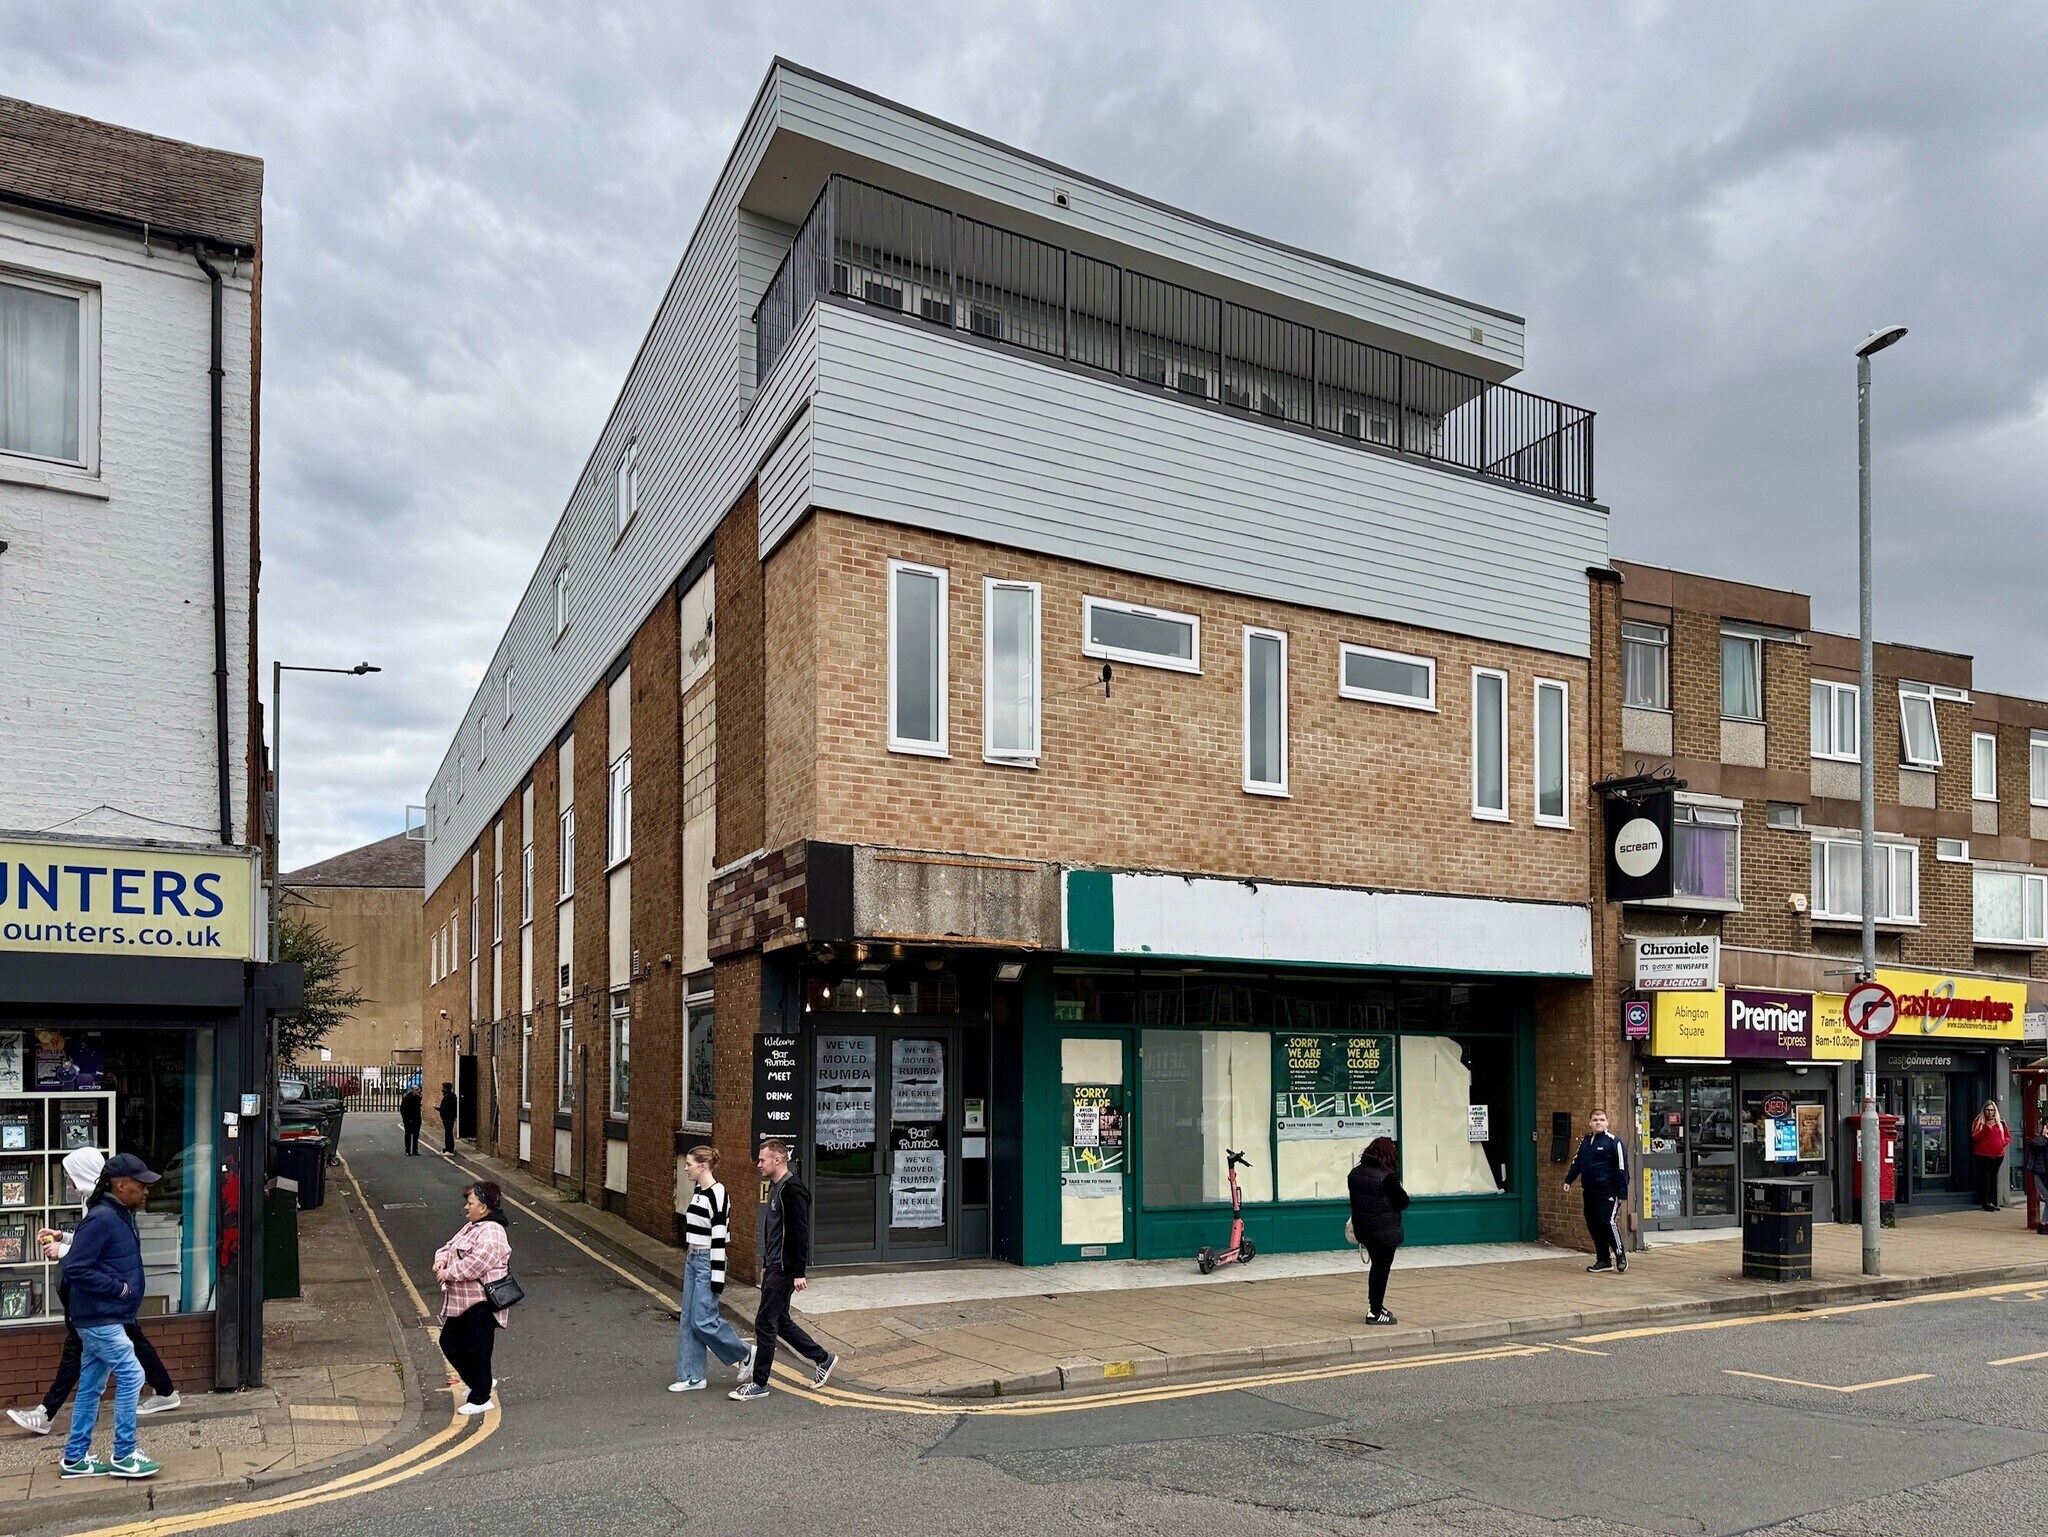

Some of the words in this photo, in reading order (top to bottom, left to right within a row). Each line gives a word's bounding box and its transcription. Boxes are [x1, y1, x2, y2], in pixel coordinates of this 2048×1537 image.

[1619, 841, 1658, 853] scream
[0, 861, 224, 918] NTERS
[3, 921, 222, 947] ounters.co.uk
[1640, 941, 1709, 956] Chronicle
[1644, 980, 1662, 988] OFF
[1663, 979, 1704, 987] LICENCE
[1674, 1005, 1709, 1022] Abington
[1731, 999, 1807, 1033] Premier
[1679, 1023, 1705, 1039] Square
[764, 1036, 795, 1047] Welcome
[825, 1040, 864, 1050] WE'VE
[1290, 1038, 1319, 1048] SORRY
[1348, 1038, 1377, 1048] SORRY
[1778, 1032, 1807, 1050] Express
[1815, 1034, 1860, 1049] 9am-10.30pm
[771, 1049, 788, 1060] Bar
[1288, 1048, 1302, 1059] WE
[1303, 1049, 1322, 1059] ARE
[1347, 1049, 1360, 1059] WE
[1362, 1049, 1380, 1059] ARE
[764, 1059, 796, 1067] Rumba
[823, 1055, 867, 1064] MOVED
[1288, 1058, 1321, 1069] CLOSED
[1347, 1059, 1380, 1069] CLOSED
[1888, 1053, 1952, 1067] cashconverters
[767, 1071, 792, 1082] MEET
[819, 1069, 871, 1080] RUMBA
[899, 1067, 937, 1075] RUMBA
[766, 1091, 793, 1101] DRINK
[1075, 1087, 1109, 1098] SORRY
[817, 1101, 831, 1111] IN
[835, 1101, 871, 1111] EXILE
[1073, 1098, 1089, 1107] WE
[1092, 1098, 1111, 1108] ARE
[1764, 1100, 1788, 1113] OPEN
[767, 1111, 791, 1121] VIBES
[833, 1128, 857, 1139] Bar
[908, 1127, 930, 1139] Bar
[824, 1140, 867, 1151] Rumba
[898, 1138, 940, 1150] Rumba
[900, 1176, 936, 1184] RUMBA
